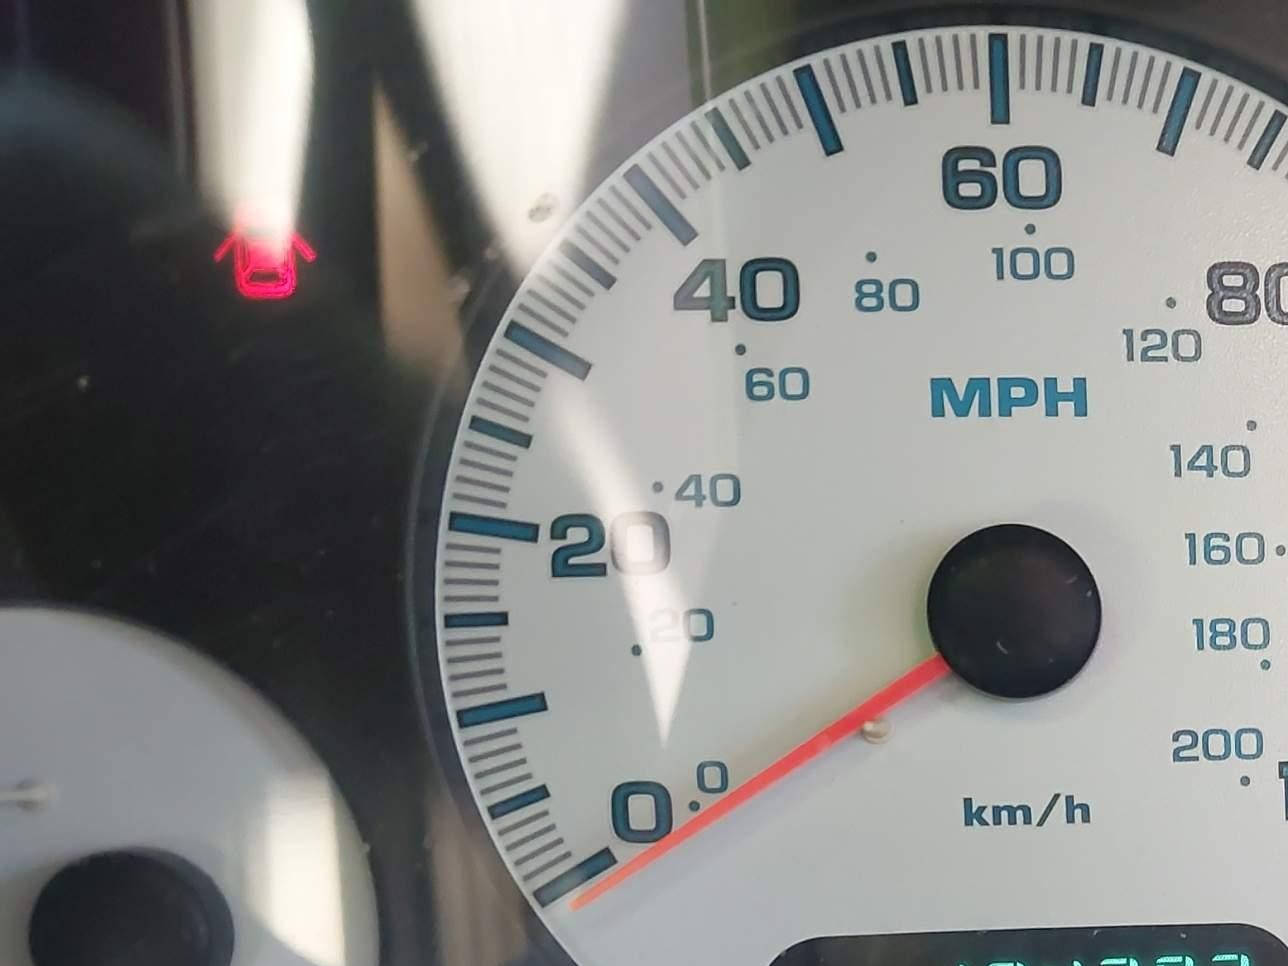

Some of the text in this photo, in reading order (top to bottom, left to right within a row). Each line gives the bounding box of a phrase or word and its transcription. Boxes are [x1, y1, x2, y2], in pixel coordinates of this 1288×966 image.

[941, 145, 1063, 210] 60
[992, 246, 1075, 281] 100
[673, 257, 800, 322] 40
[854, 278, 920, 312] 80
[1122, 328, 1202, 362] 120
[744, 367, 810, 401] 60
[929, 376, 1088, 418] MPH
[1170, 444, 1251, 478] 140
[674, 473, 741, 508] 40
[549, 511, 671, 578] 20
[1184, 531, 1265, 566] 160
[649, 608, 715, 643] 20
[1192, 616, 1271, 651] 180
[1171, 727, 1264, 763] 200
[696, 760, 728, 794] 0
[610, 780, 673, 844] 0
[963, 793, 1091, 827] km/h
